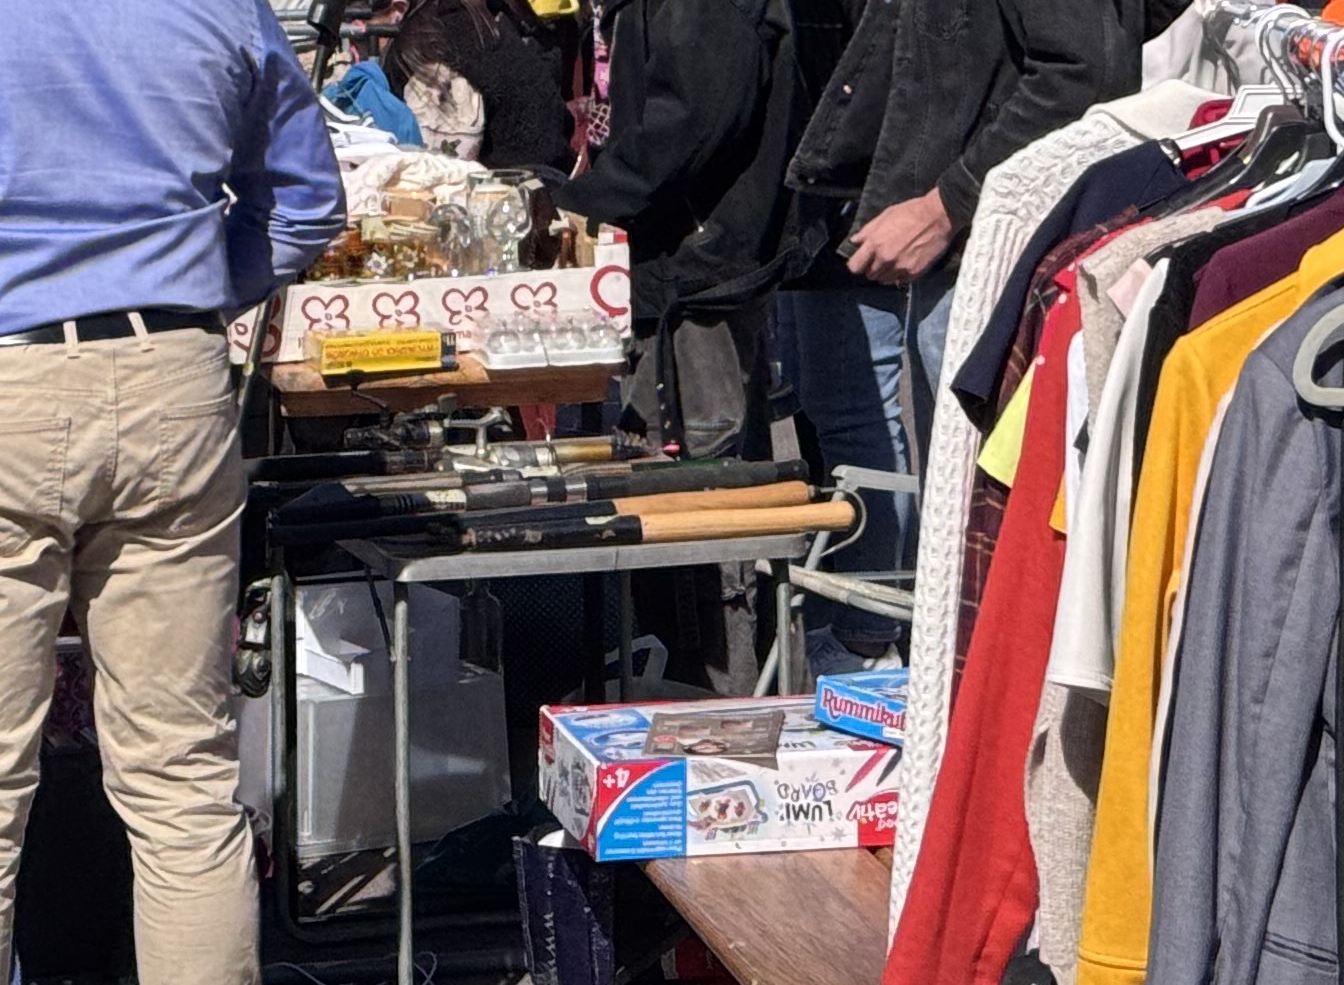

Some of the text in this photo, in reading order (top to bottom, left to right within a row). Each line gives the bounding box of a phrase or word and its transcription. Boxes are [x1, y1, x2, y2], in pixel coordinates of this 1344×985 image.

[823, 687, 907, 731] Rummiku
[602, 767, 630, 789] 4+
[784, 800, 834, 823] LUMI
[845, 800, 898, 822] eativ
